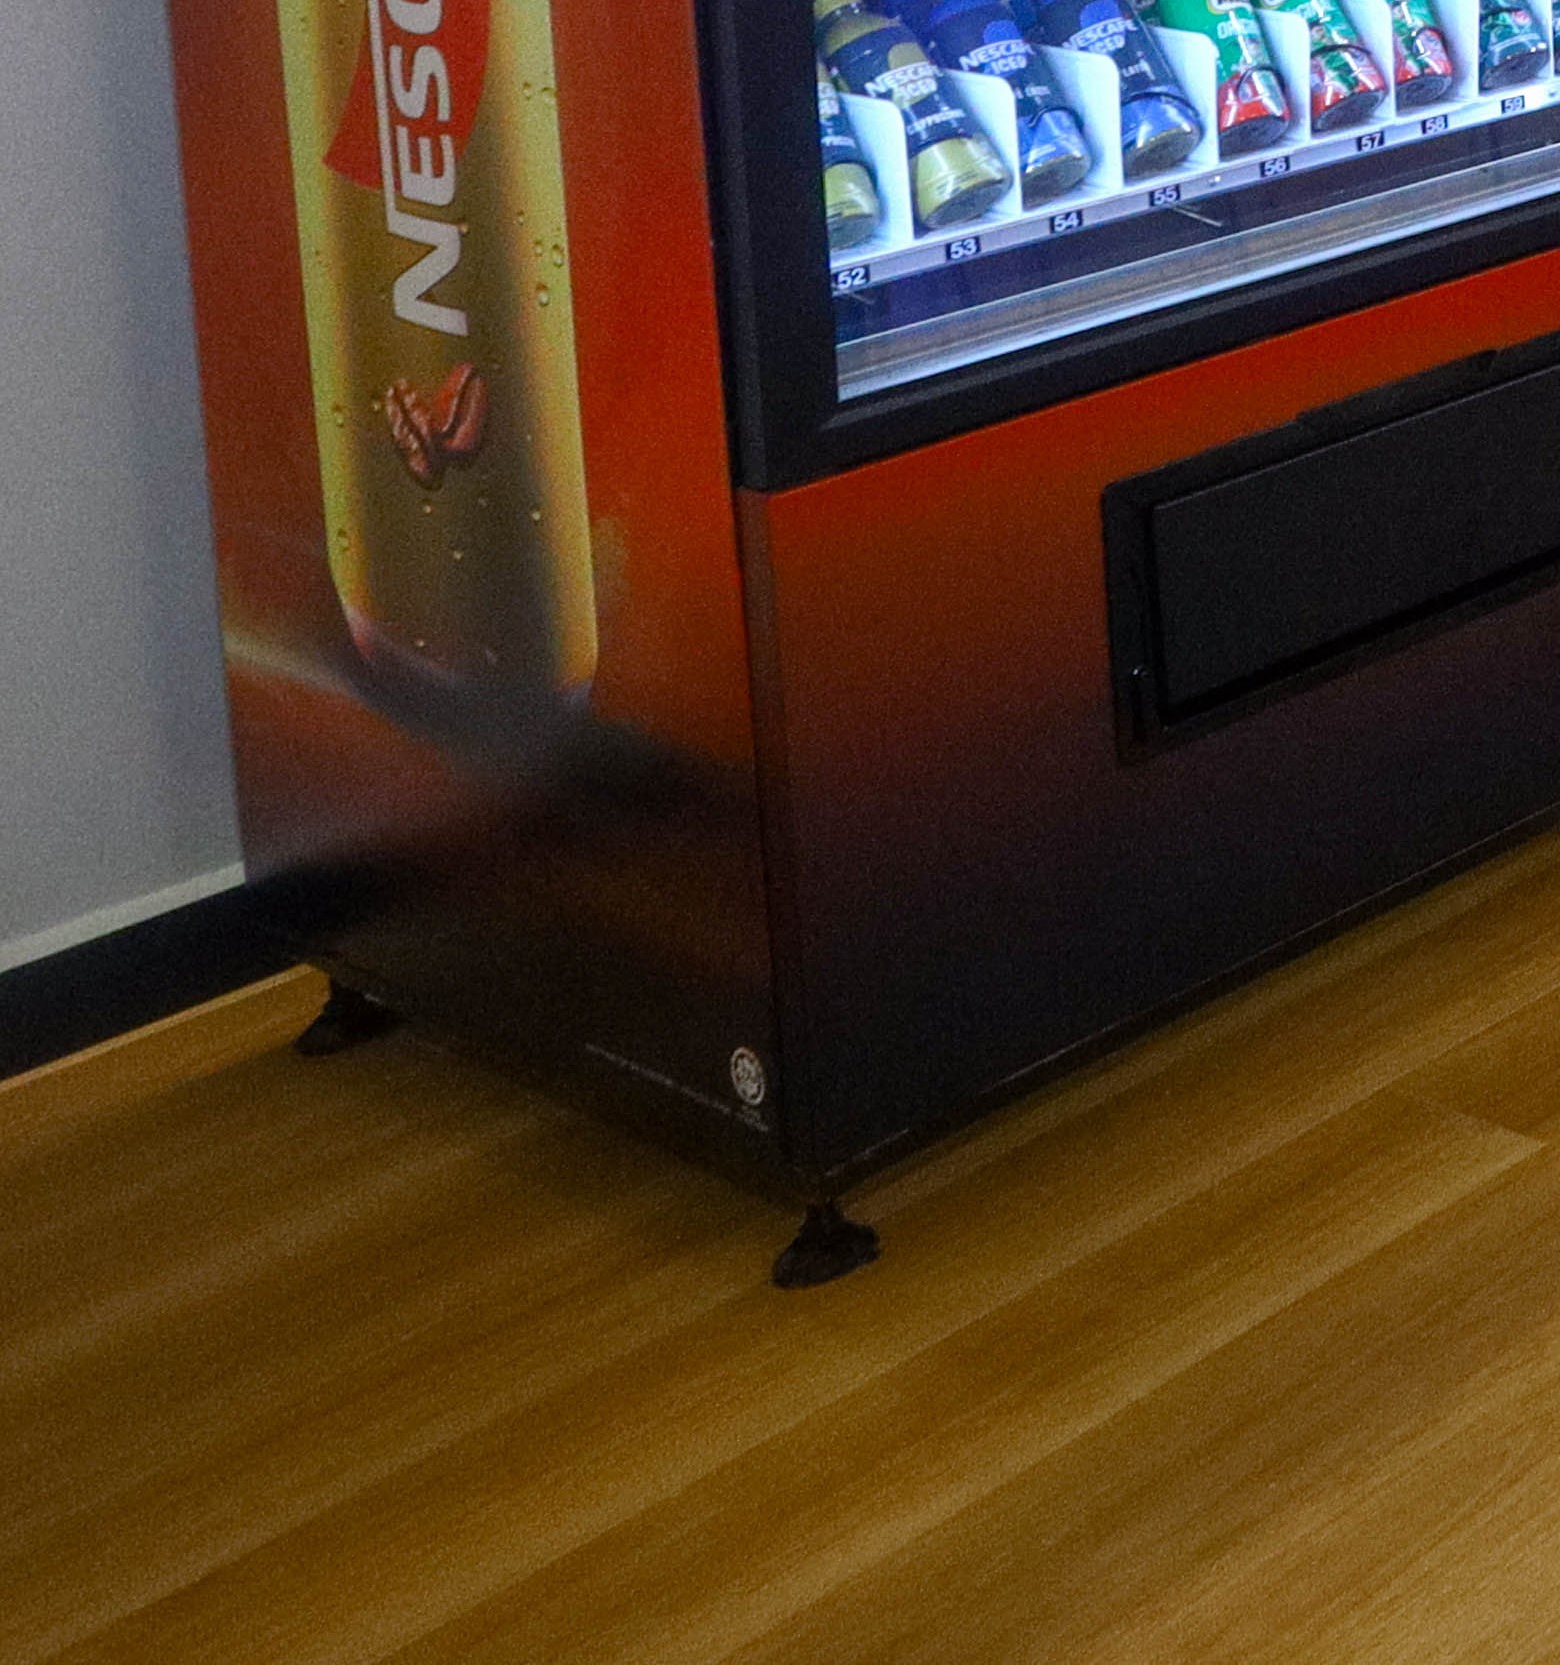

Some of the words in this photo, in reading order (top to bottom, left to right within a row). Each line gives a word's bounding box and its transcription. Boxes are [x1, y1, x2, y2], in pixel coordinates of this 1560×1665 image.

[1503, 96, 1524, 112] 59
[1425, 117, 1447, 134] 58
[1359, 134, 1382, 151] 57
[1263, 158, 1287, 175] 56
[1154, 186, 1178, 204] 55
[1054, 213, 1080, 231] 54
[950, 239, 978, 257] 53
[837, 268, 866, 287] 52
